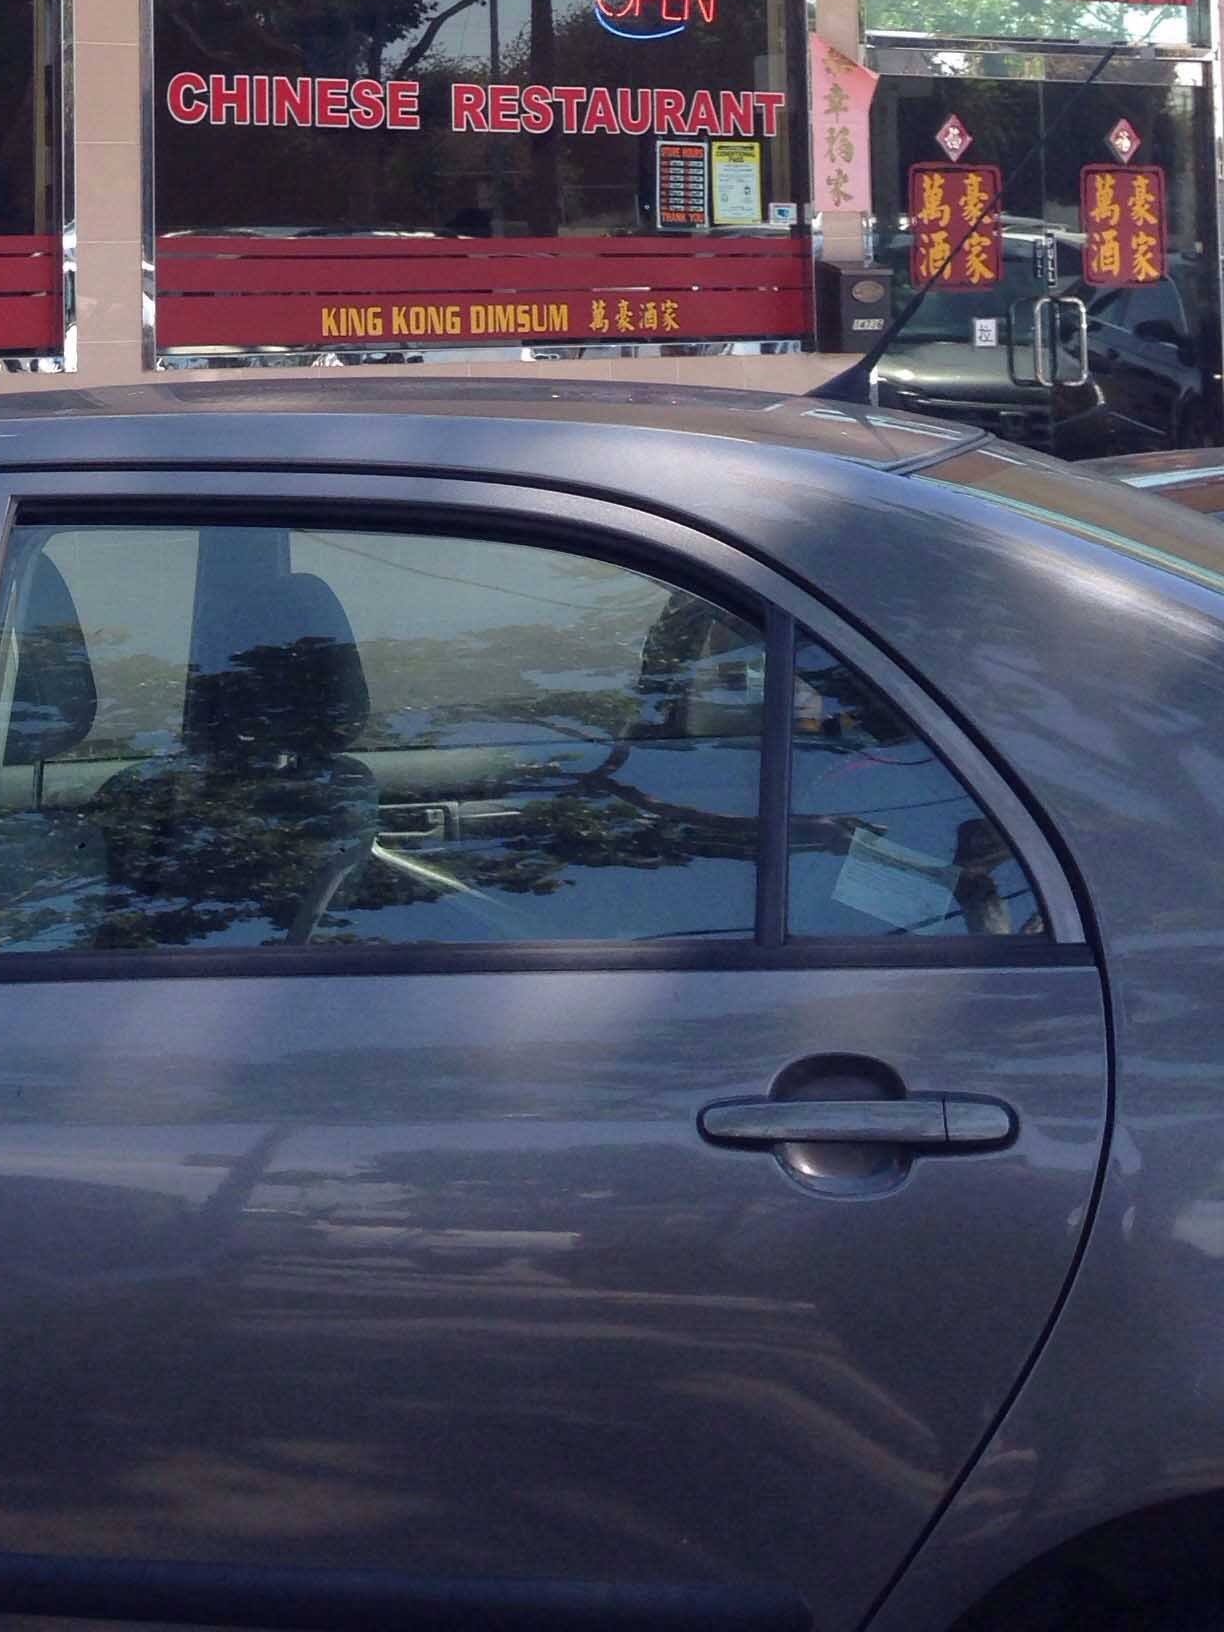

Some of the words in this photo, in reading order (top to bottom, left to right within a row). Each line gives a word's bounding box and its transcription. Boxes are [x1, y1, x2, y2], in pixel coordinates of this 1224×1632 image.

[167, 72, 421, 131] CHINESE
[451, 83, 784, 137] RESTAURANT
[321, 306, 384, 337] KING
[392, 305, 462, 336] KONG
[470, 304, 570, 334] DIMSUM
[588, 298, 681, 333] 萬豪酒家
